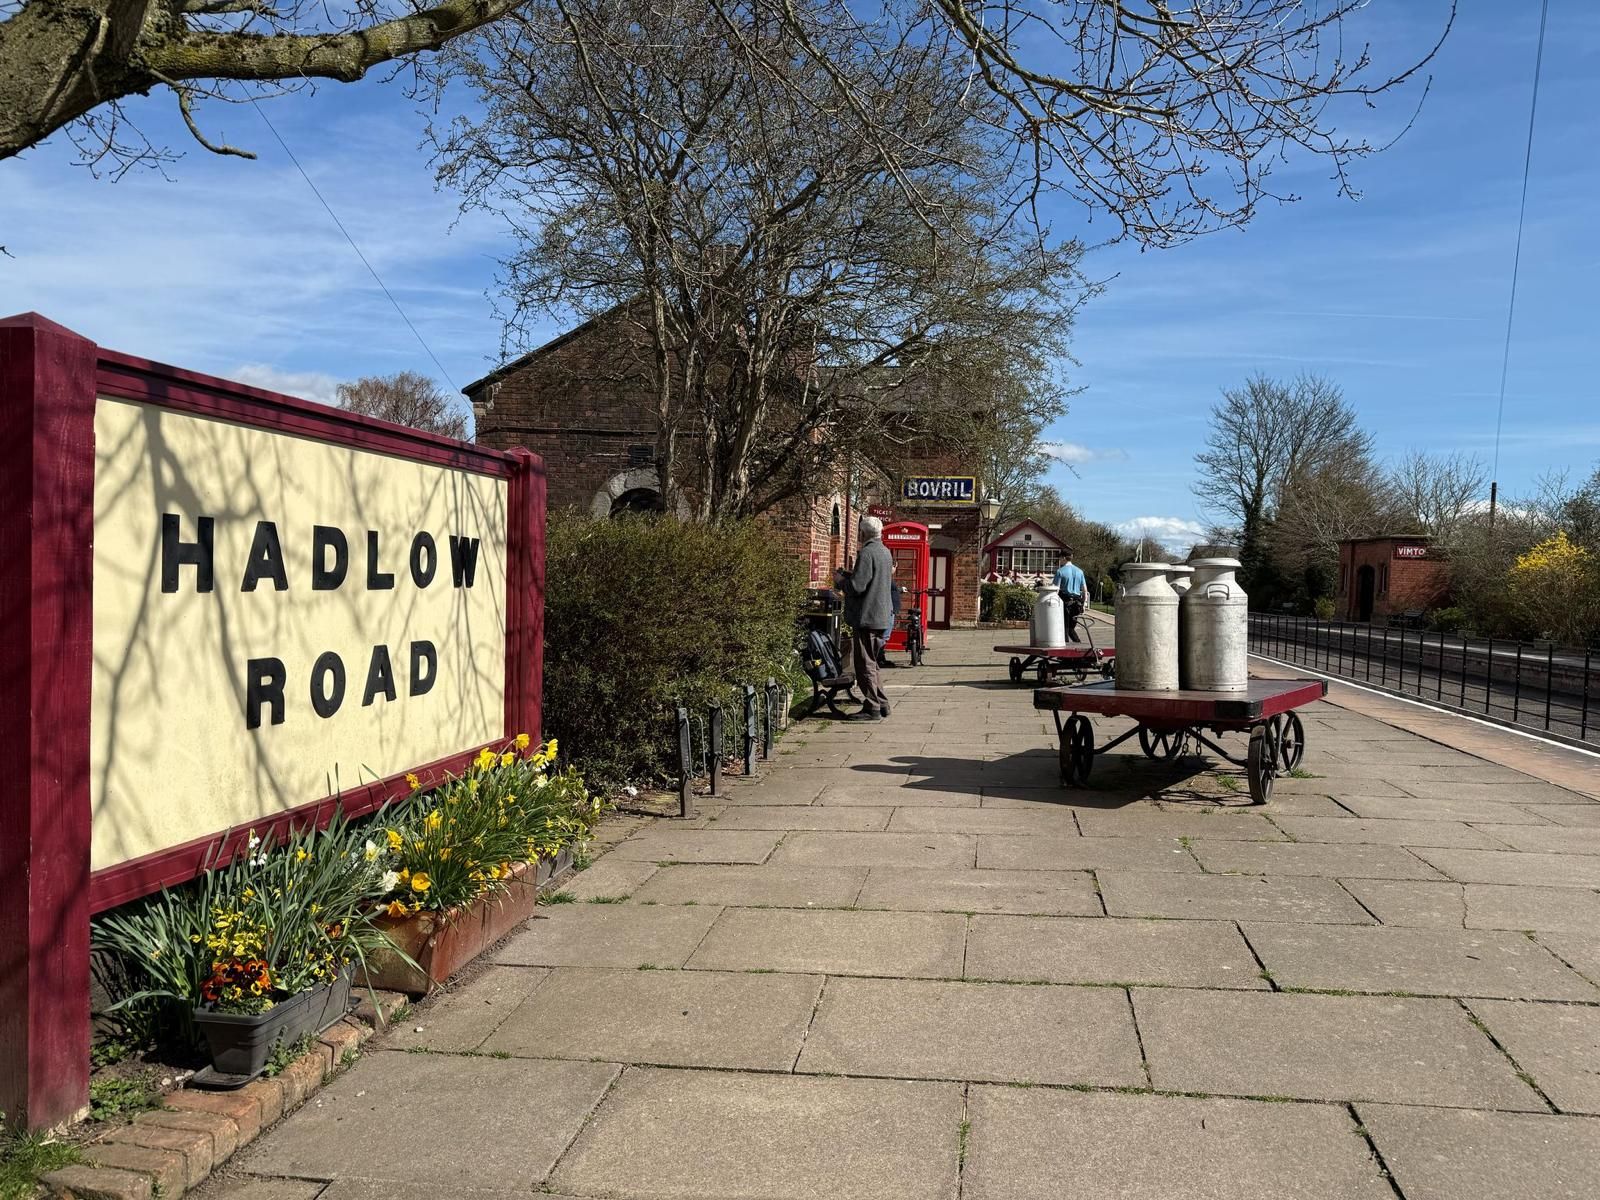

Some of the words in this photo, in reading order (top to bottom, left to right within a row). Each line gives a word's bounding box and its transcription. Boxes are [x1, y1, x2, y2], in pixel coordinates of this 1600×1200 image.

[908, 481, 972, 497] BOVRIL
[161, 513, 480, 593] HADLOW
[1398, 548, 1425, 556] VIMTO
[246, 640, 437, 730] ROAD
